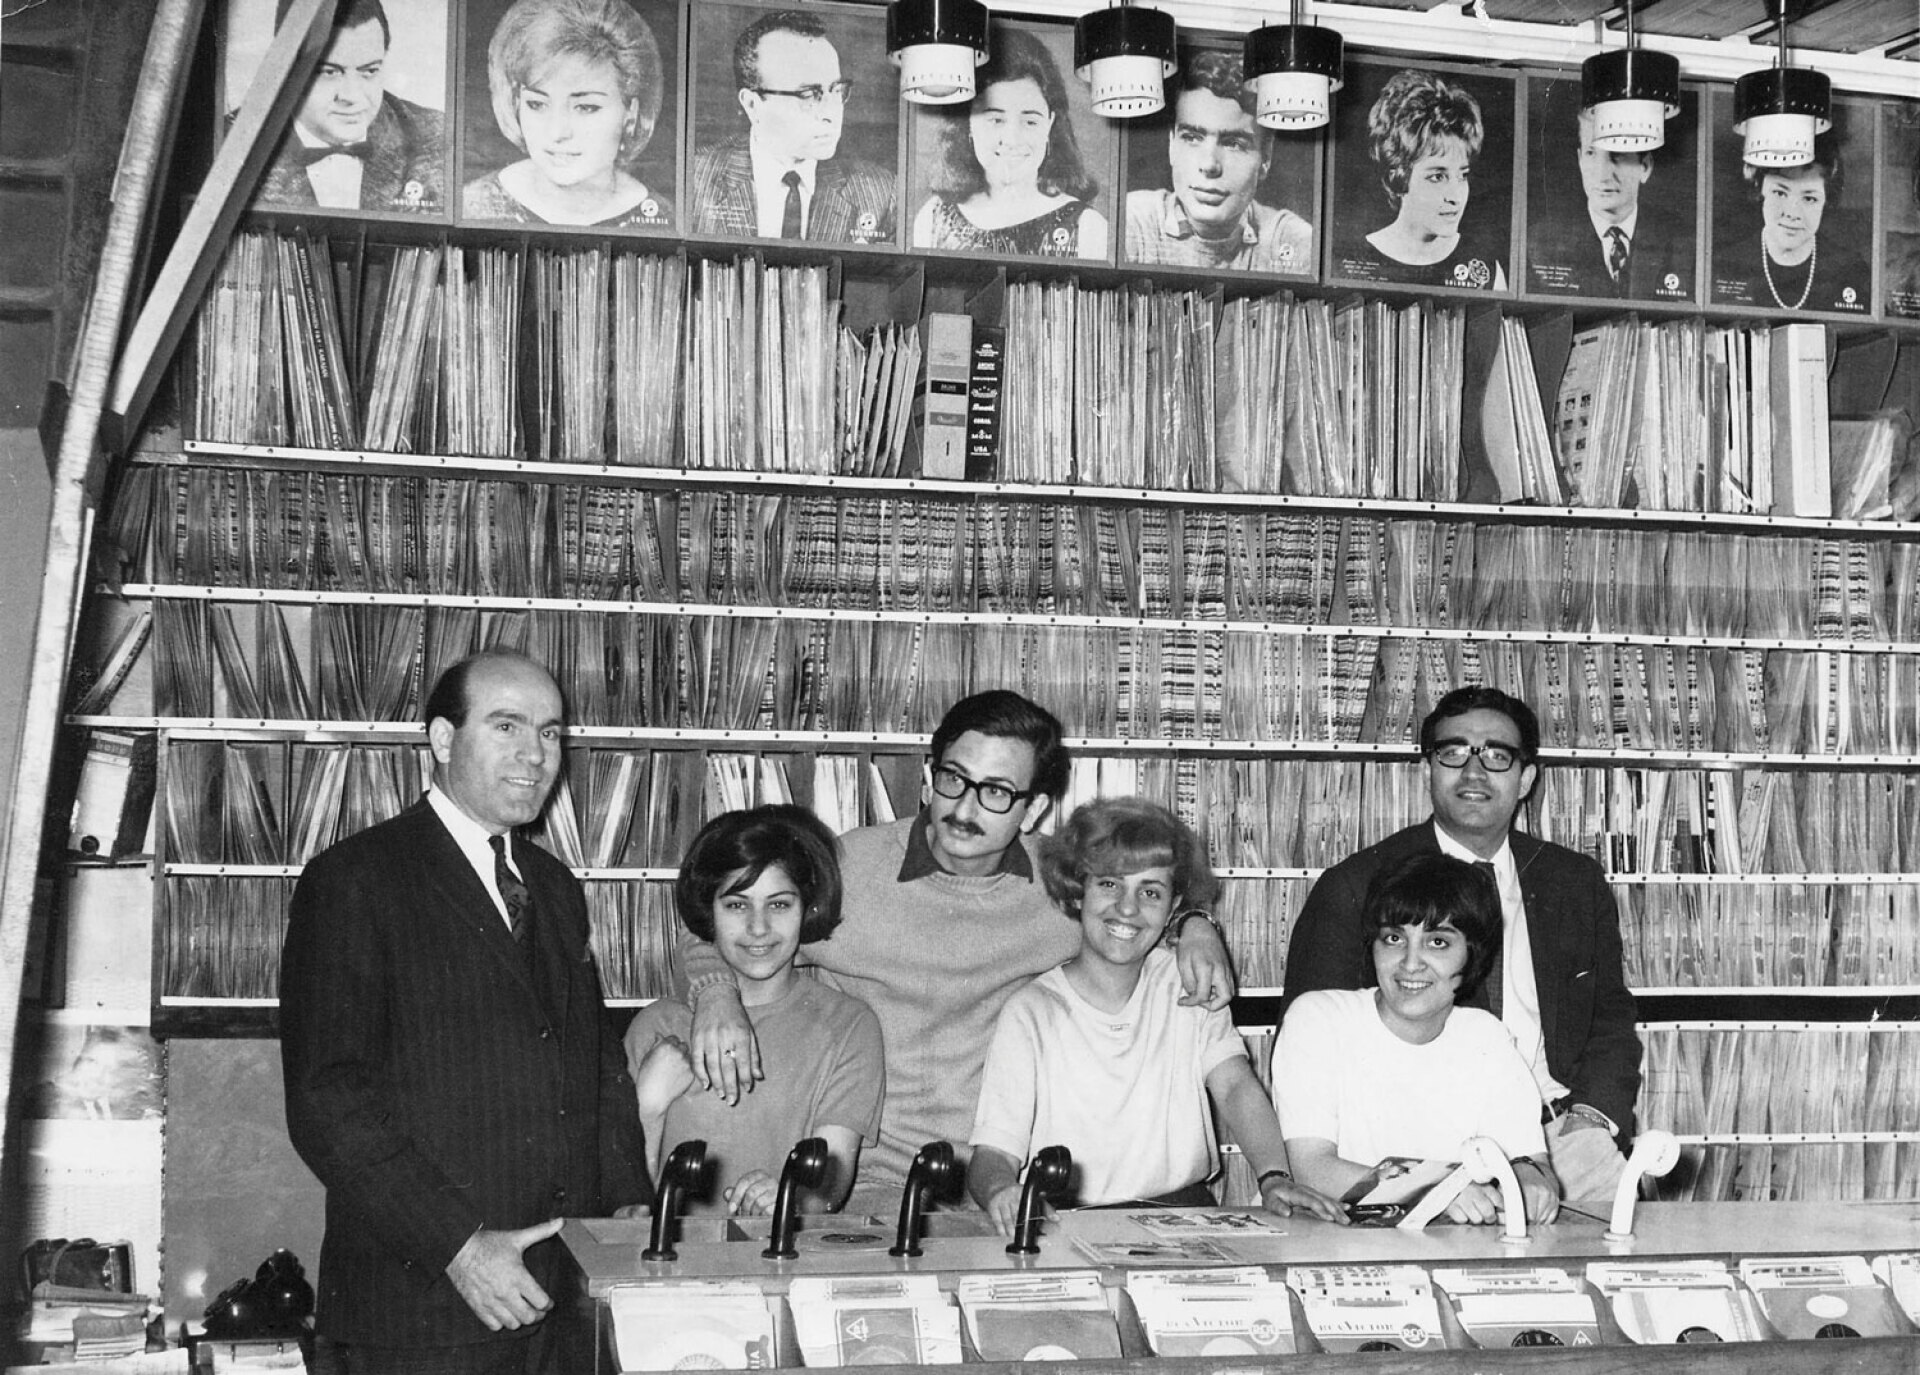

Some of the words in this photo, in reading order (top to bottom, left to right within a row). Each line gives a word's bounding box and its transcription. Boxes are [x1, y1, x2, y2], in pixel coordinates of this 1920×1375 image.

[630, 215, 669, 224] COLUMBIA
[849, 229, 886, 238] COLUMBIA
[1445, 279, 1477, 288] COLUMBIA
[1655, 288, 1687, 297] COLUMBIA
[1834, 302, 1864, 310] COLUMBIA
